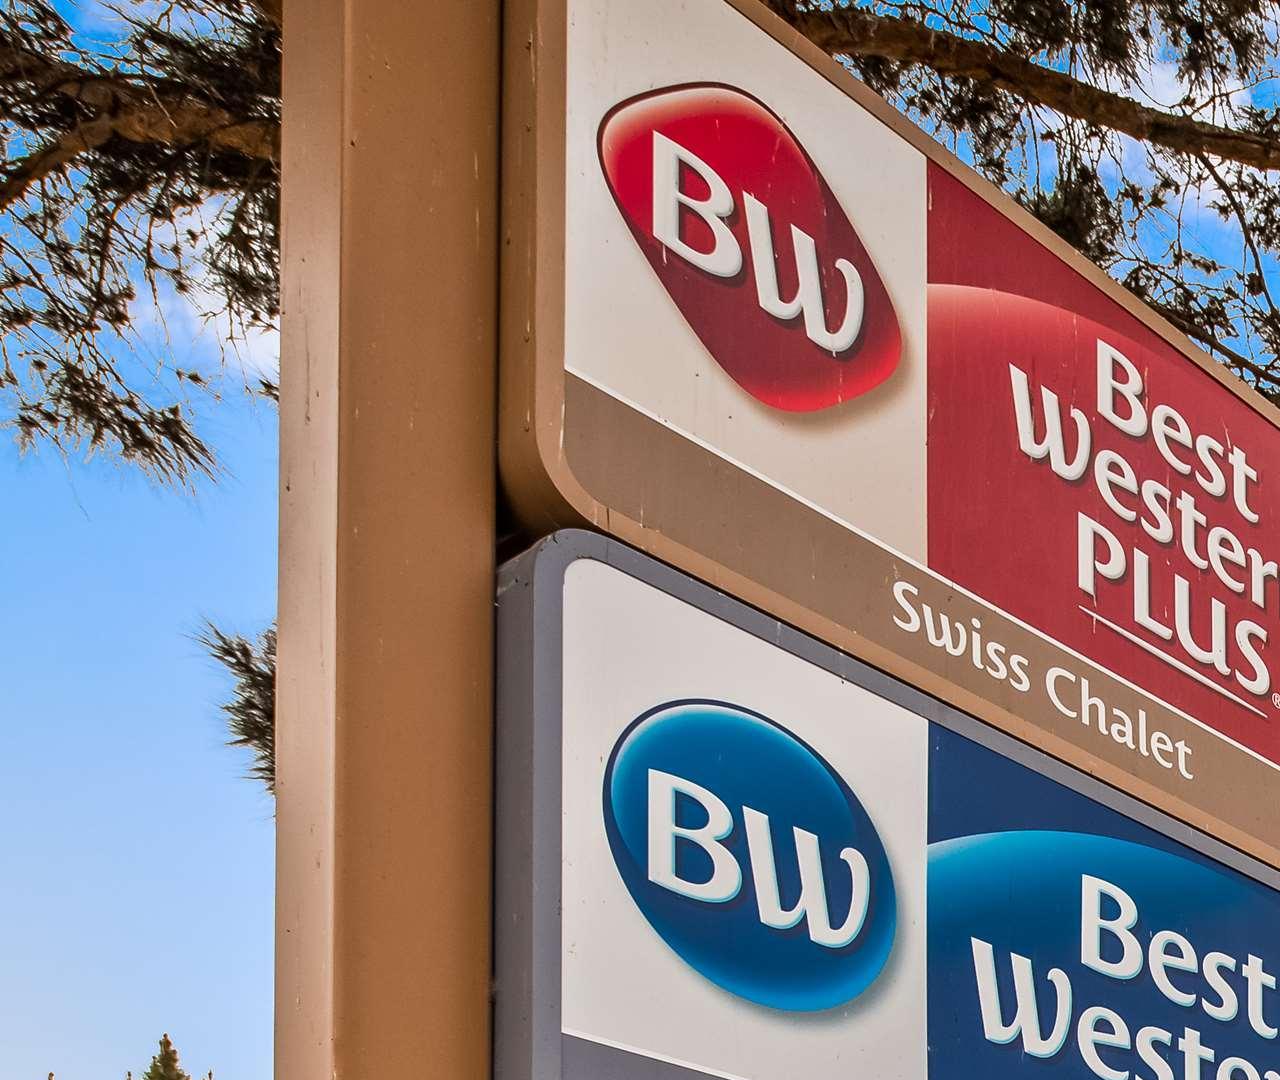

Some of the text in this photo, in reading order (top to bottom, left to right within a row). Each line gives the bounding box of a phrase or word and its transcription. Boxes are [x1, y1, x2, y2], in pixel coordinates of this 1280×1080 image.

[652, 130, 865, 357] BW
[1096, 338, 1260, 524] Best
[892, 580, 1195, 781] Swiss Chalet
[646, 768, 870, 947] BW
[1080, 873, 1278, 1040] Best
